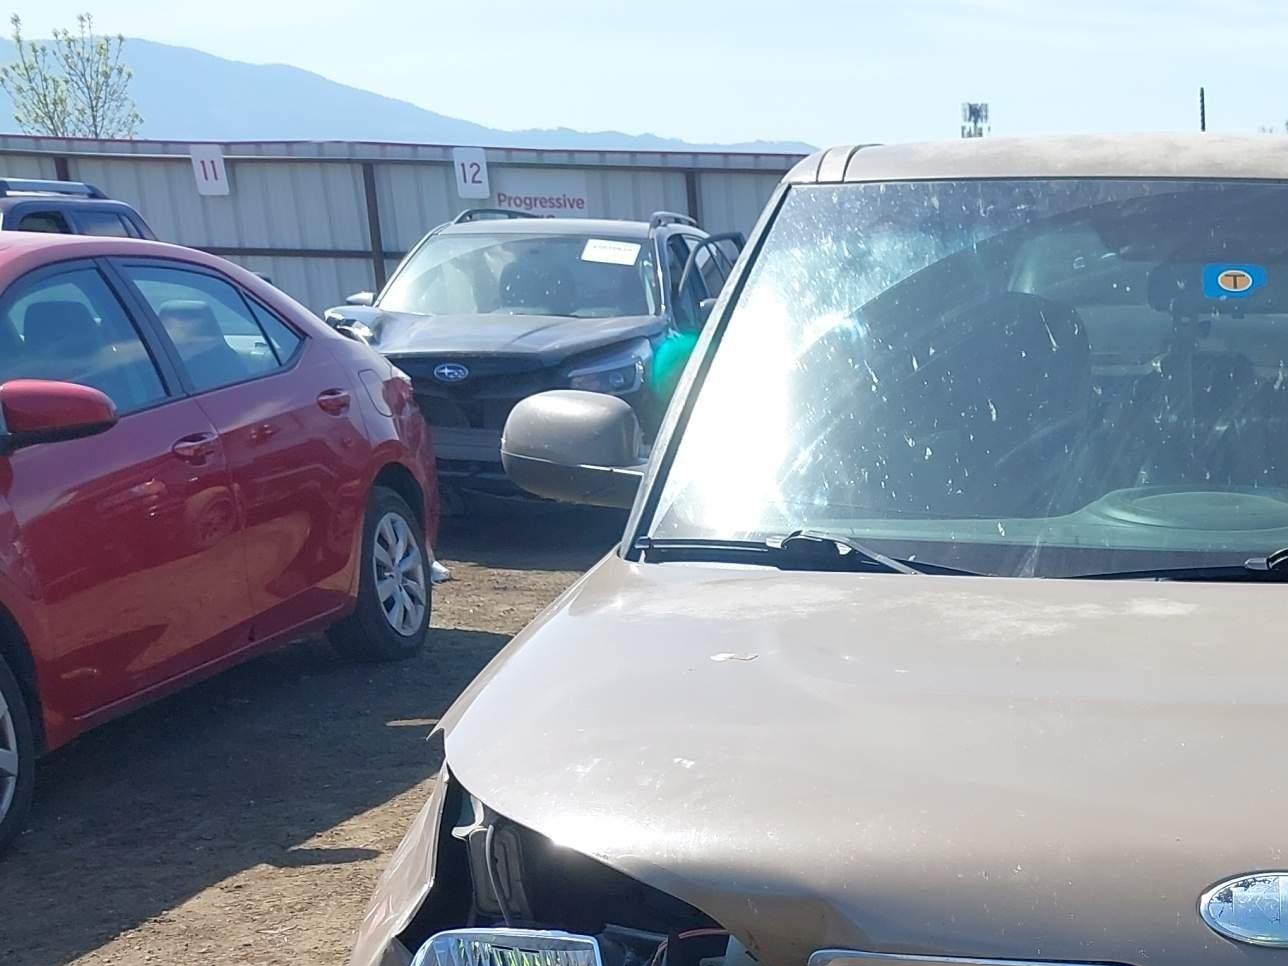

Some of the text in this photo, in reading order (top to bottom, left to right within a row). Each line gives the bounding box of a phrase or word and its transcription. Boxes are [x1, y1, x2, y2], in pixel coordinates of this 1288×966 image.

[200, 160, 218, 181] 11
[460, 163, 482, 184] 12
[497, 192, 585, 210] Progressive
[1224, 274, 1246, 289] T
